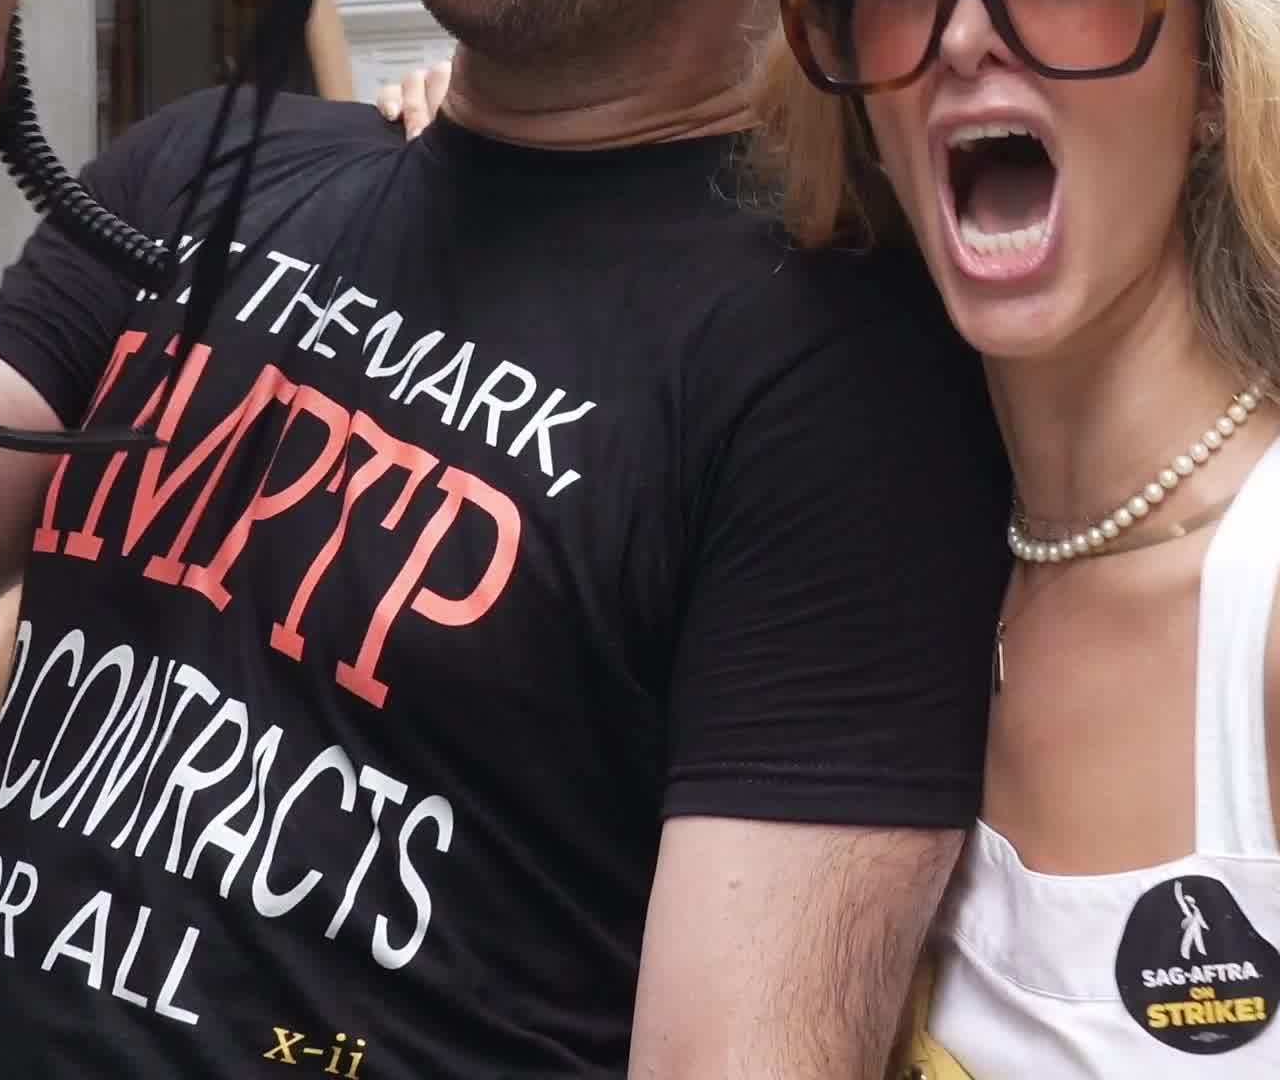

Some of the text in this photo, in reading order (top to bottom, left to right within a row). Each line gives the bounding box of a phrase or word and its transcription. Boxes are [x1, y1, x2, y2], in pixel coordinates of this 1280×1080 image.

[235, 250, 378, 359] THE
[362, 310, 597, 498] MARK,
[41, 890, 200, 1025] ALL
[1189, 985, 1215, 1001] ON
[1146, 996, 1268, 1029] STRIKE!
